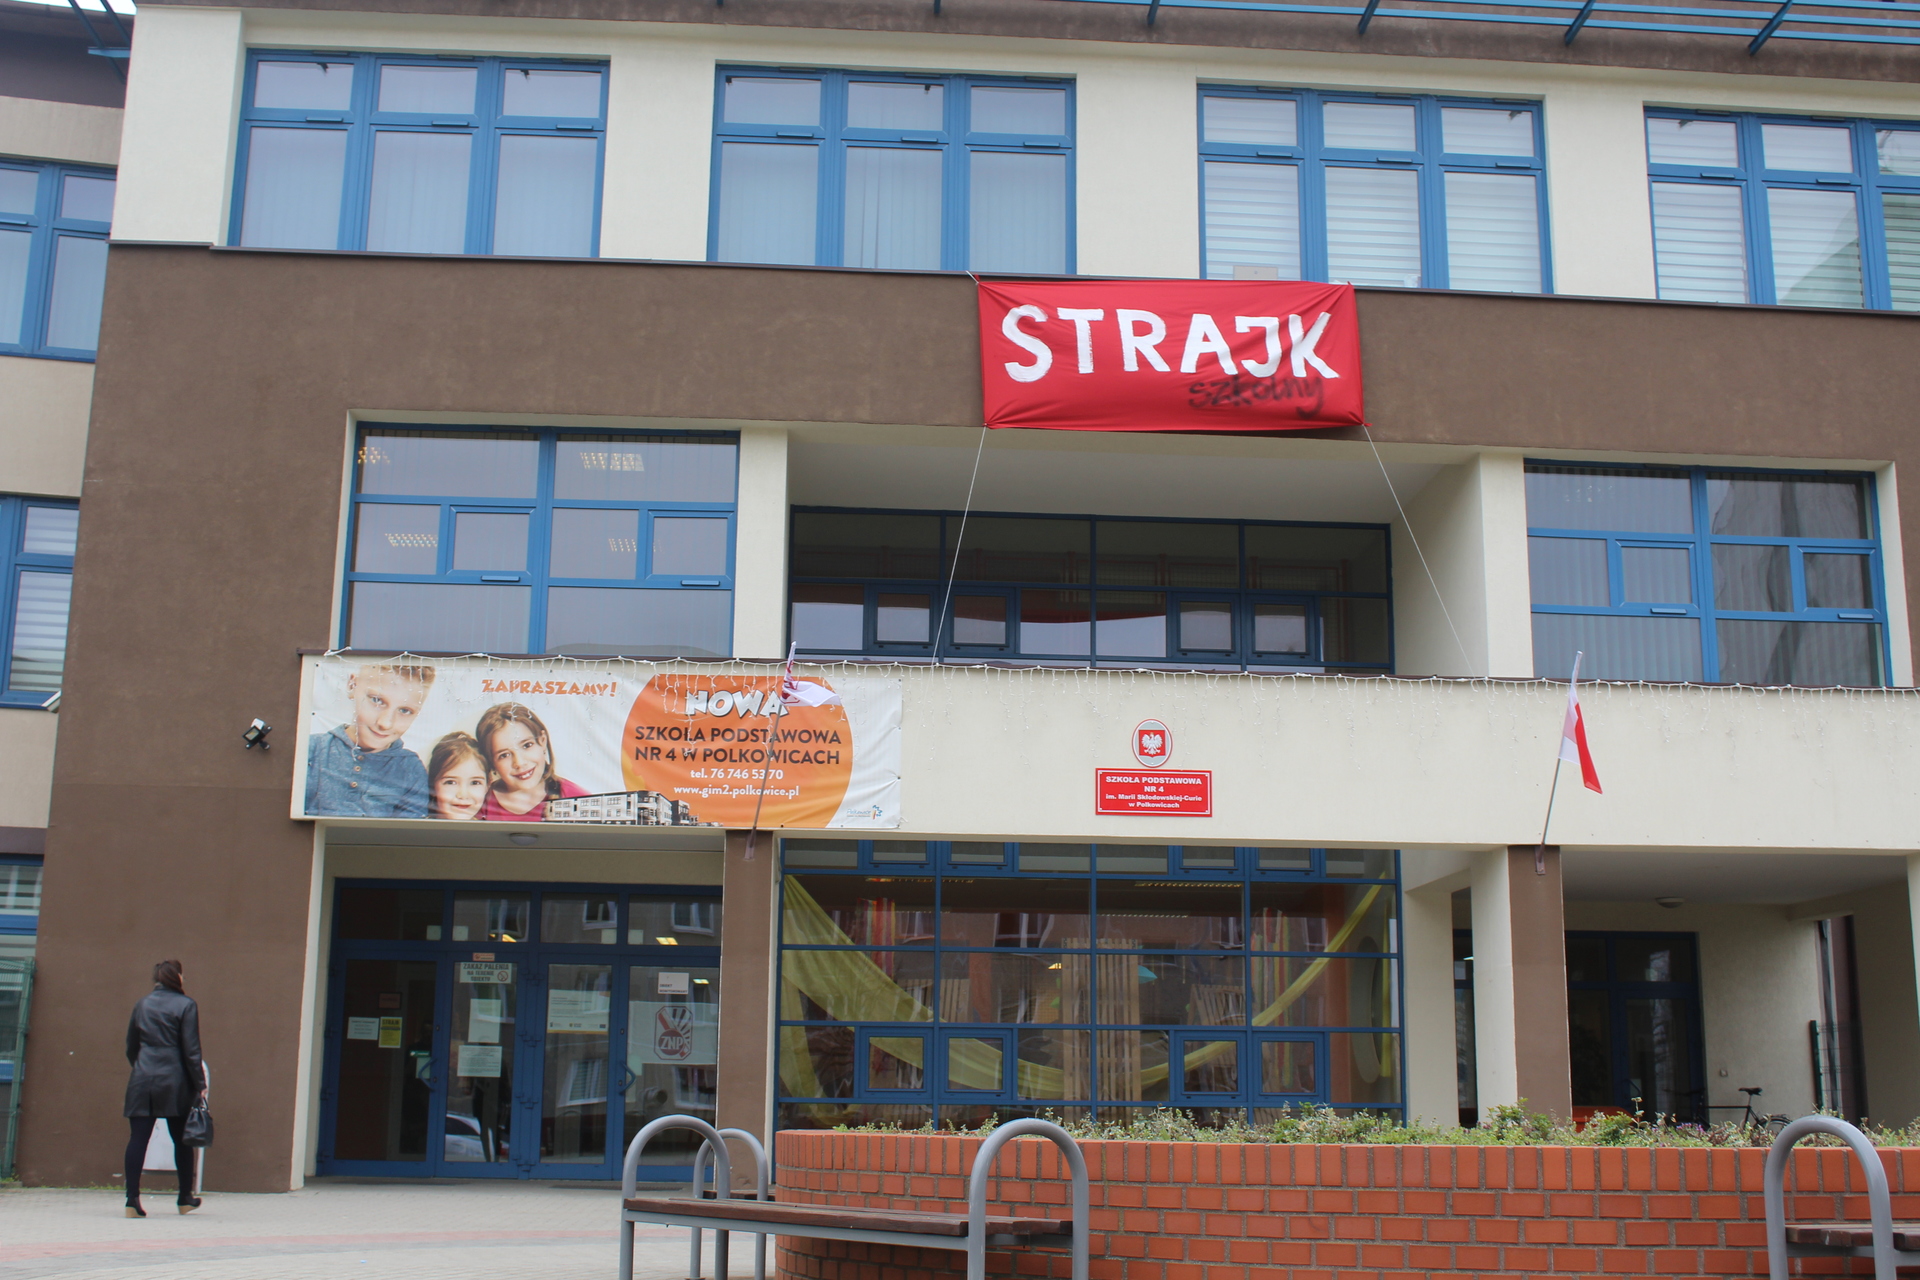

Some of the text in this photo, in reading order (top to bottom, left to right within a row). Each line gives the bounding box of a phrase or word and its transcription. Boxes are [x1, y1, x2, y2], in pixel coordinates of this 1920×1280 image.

[1001, 303, 1340, 383] STRAJK
[481, 679, 618, 697] ZAPRASZAMY!
[684, 689, 790, 718] NOWA
[635, 726, 842, 745] SZKOŁA PODSTAWOWA
[634, 746, 840, 765] NR 4 W POLKOWICACH
[690, 768, 784, 780] tel. 76 746 53 70
[673, 784, 800, 800] www.gim2.polkowice.pl
[660, 1036, 684, 1050] ZNP
